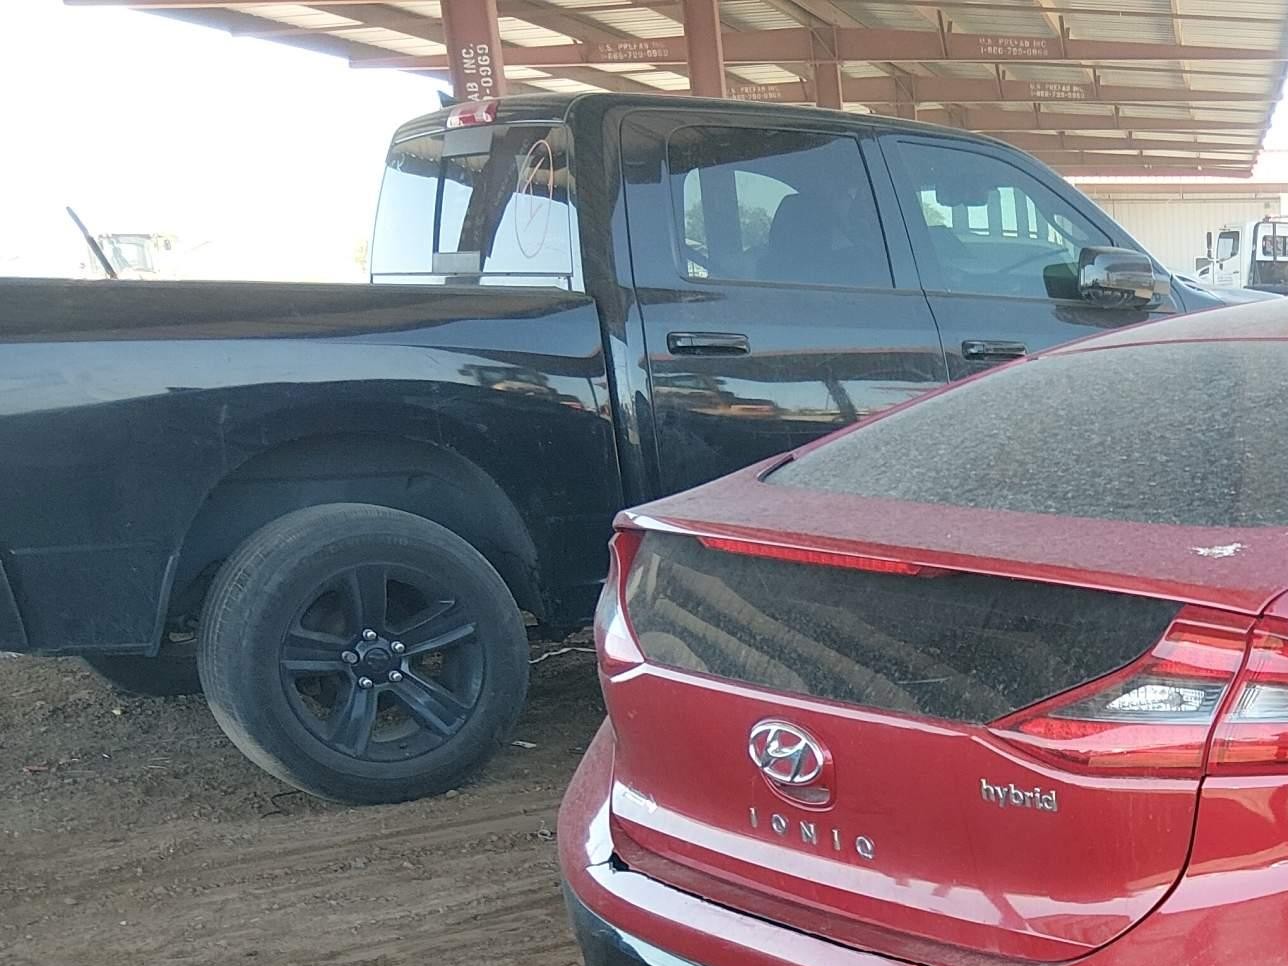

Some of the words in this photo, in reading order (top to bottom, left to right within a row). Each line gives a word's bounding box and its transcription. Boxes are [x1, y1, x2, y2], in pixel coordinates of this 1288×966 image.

[462, 43, 476, 73] INC.
[476, 44, 493, 100] -0969
[980, 778, 1058, 812] hybrid
[749, 807, 876, 860] IONIQ
